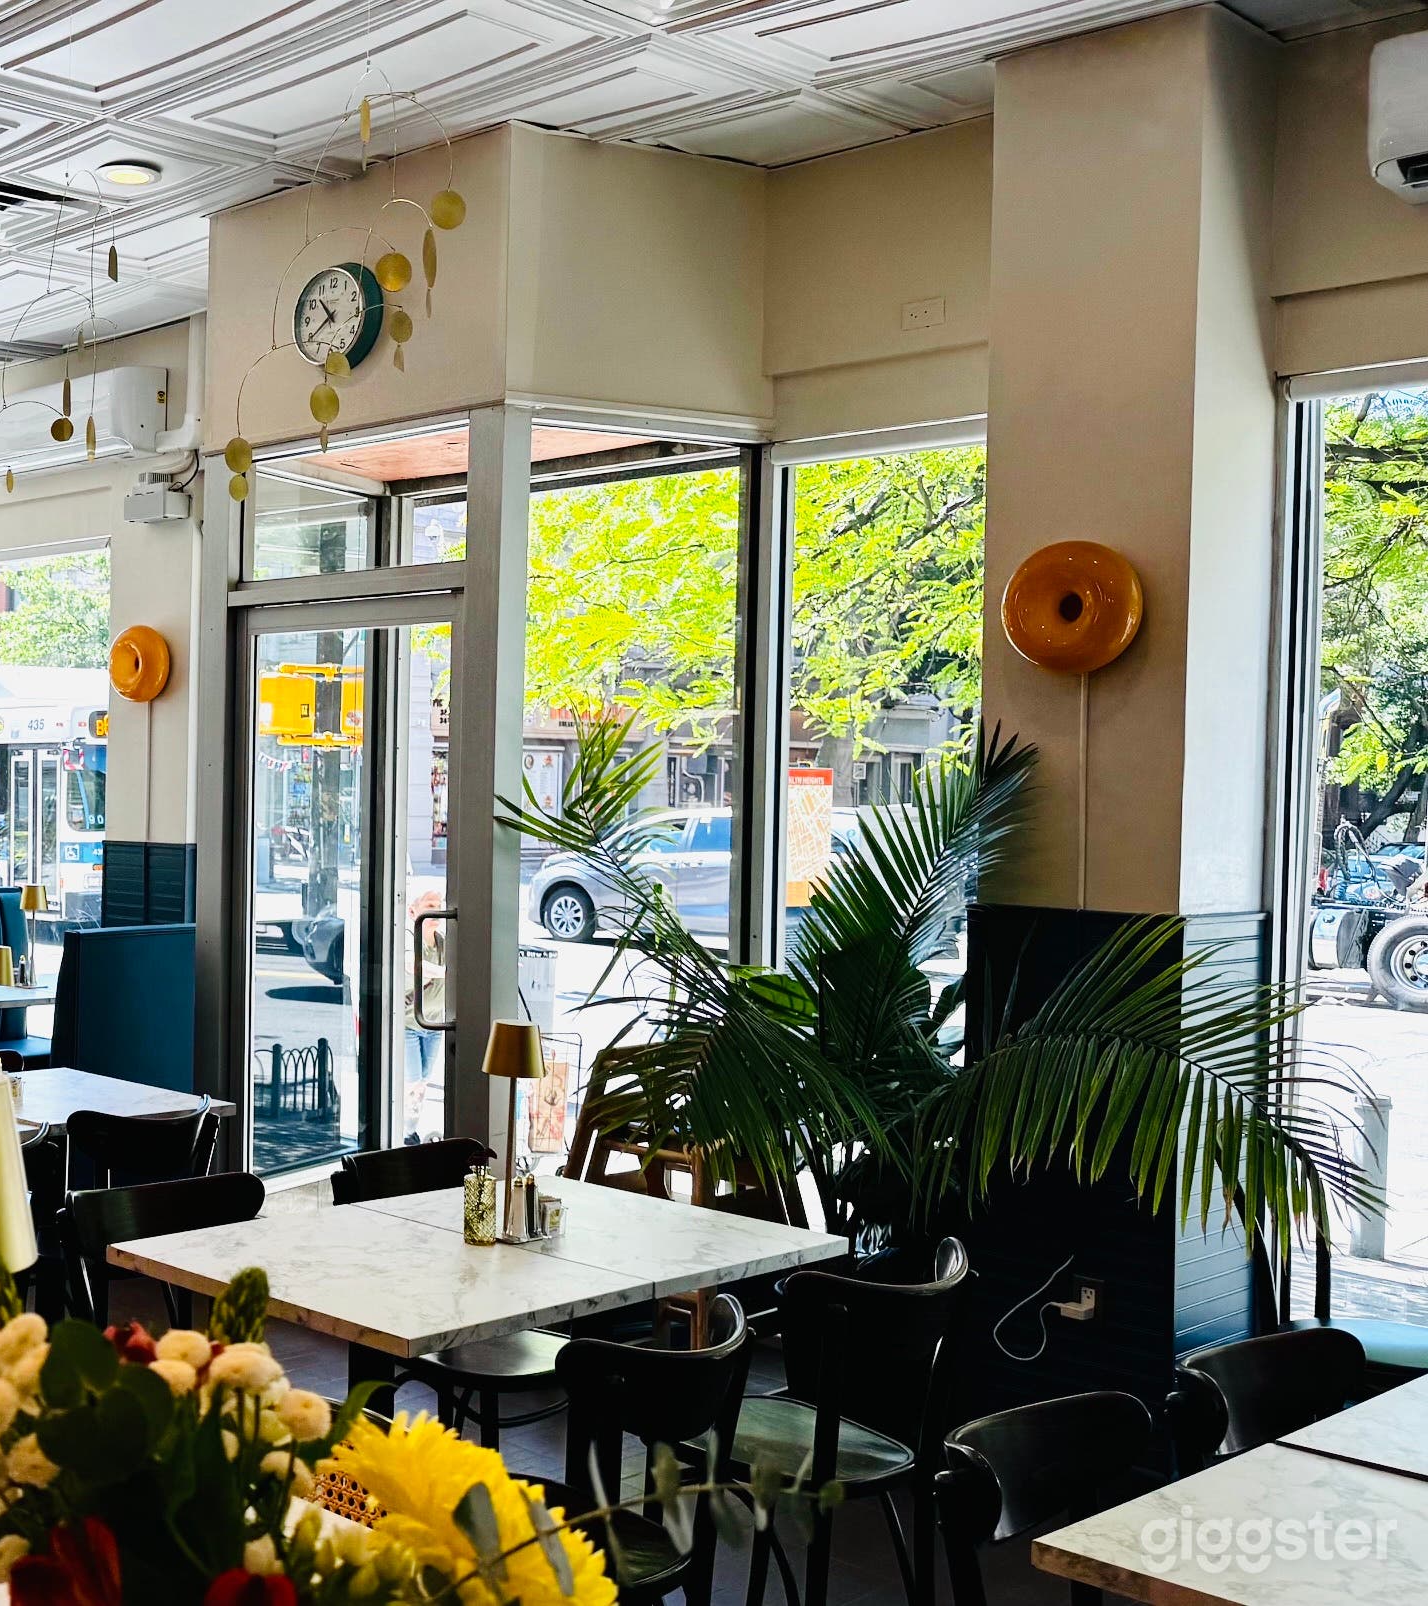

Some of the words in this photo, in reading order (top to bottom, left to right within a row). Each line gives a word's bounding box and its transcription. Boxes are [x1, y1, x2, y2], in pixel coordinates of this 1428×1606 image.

[330, 278, 338, 288] 12
[319, 285, 325, 297] 11
[351, 291, 357, 302] 2
[309, 299, 317, 311] 10
[305, 316, 311, 327] 9
[350, 325, 355, 335] 4
[316, 342, 322, 354] 7
[340, 339, 346, 349] 5
